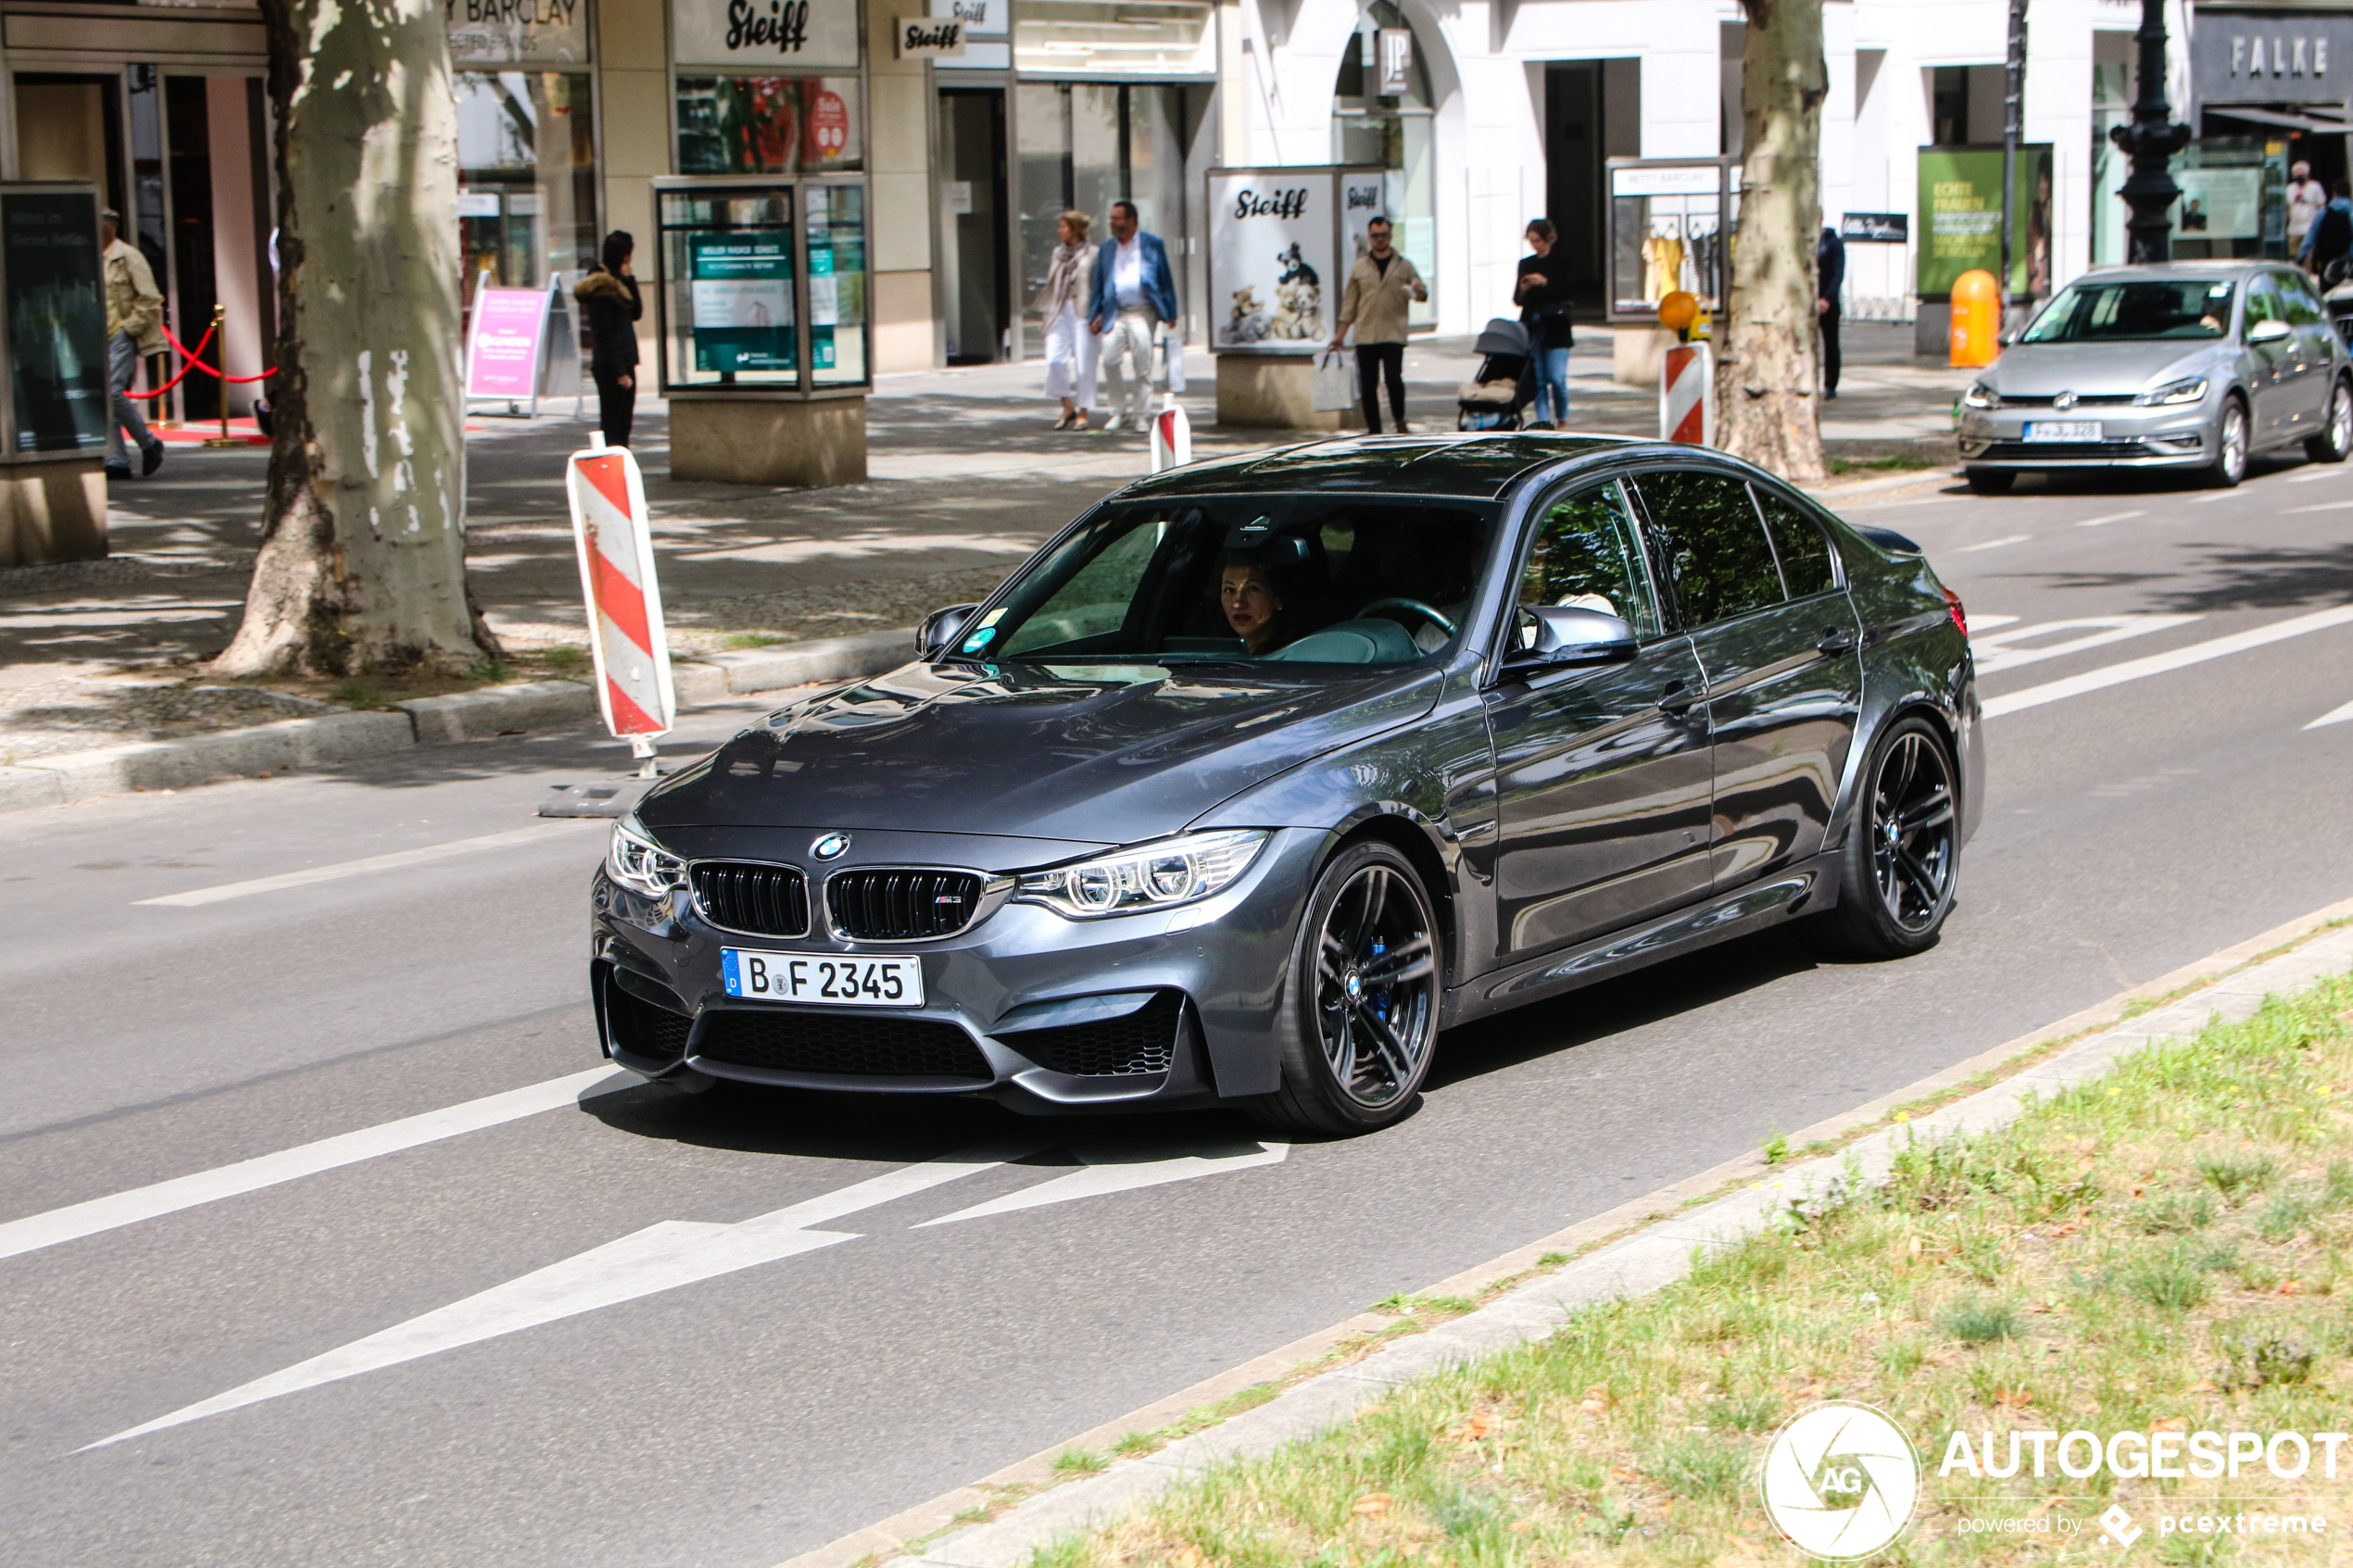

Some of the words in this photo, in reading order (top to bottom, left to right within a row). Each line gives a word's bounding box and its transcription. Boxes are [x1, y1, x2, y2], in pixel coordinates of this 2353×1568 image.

[467, 0, 576, 26] BARCLAY
[726, 0, 809, 53] Steiff
[904, 23, 962, 49] Steiff
[2231, 36, 2329, 75] FALKE
[1235, 188, 1308, 220] Steiff
[1348, 186, 1378, 210] Steiff
[730, 978, 737, 988] D
[749, 958, 769, 993] B
[789, 960, 808, 996] F
[819, 962, 903, 999] 2345
